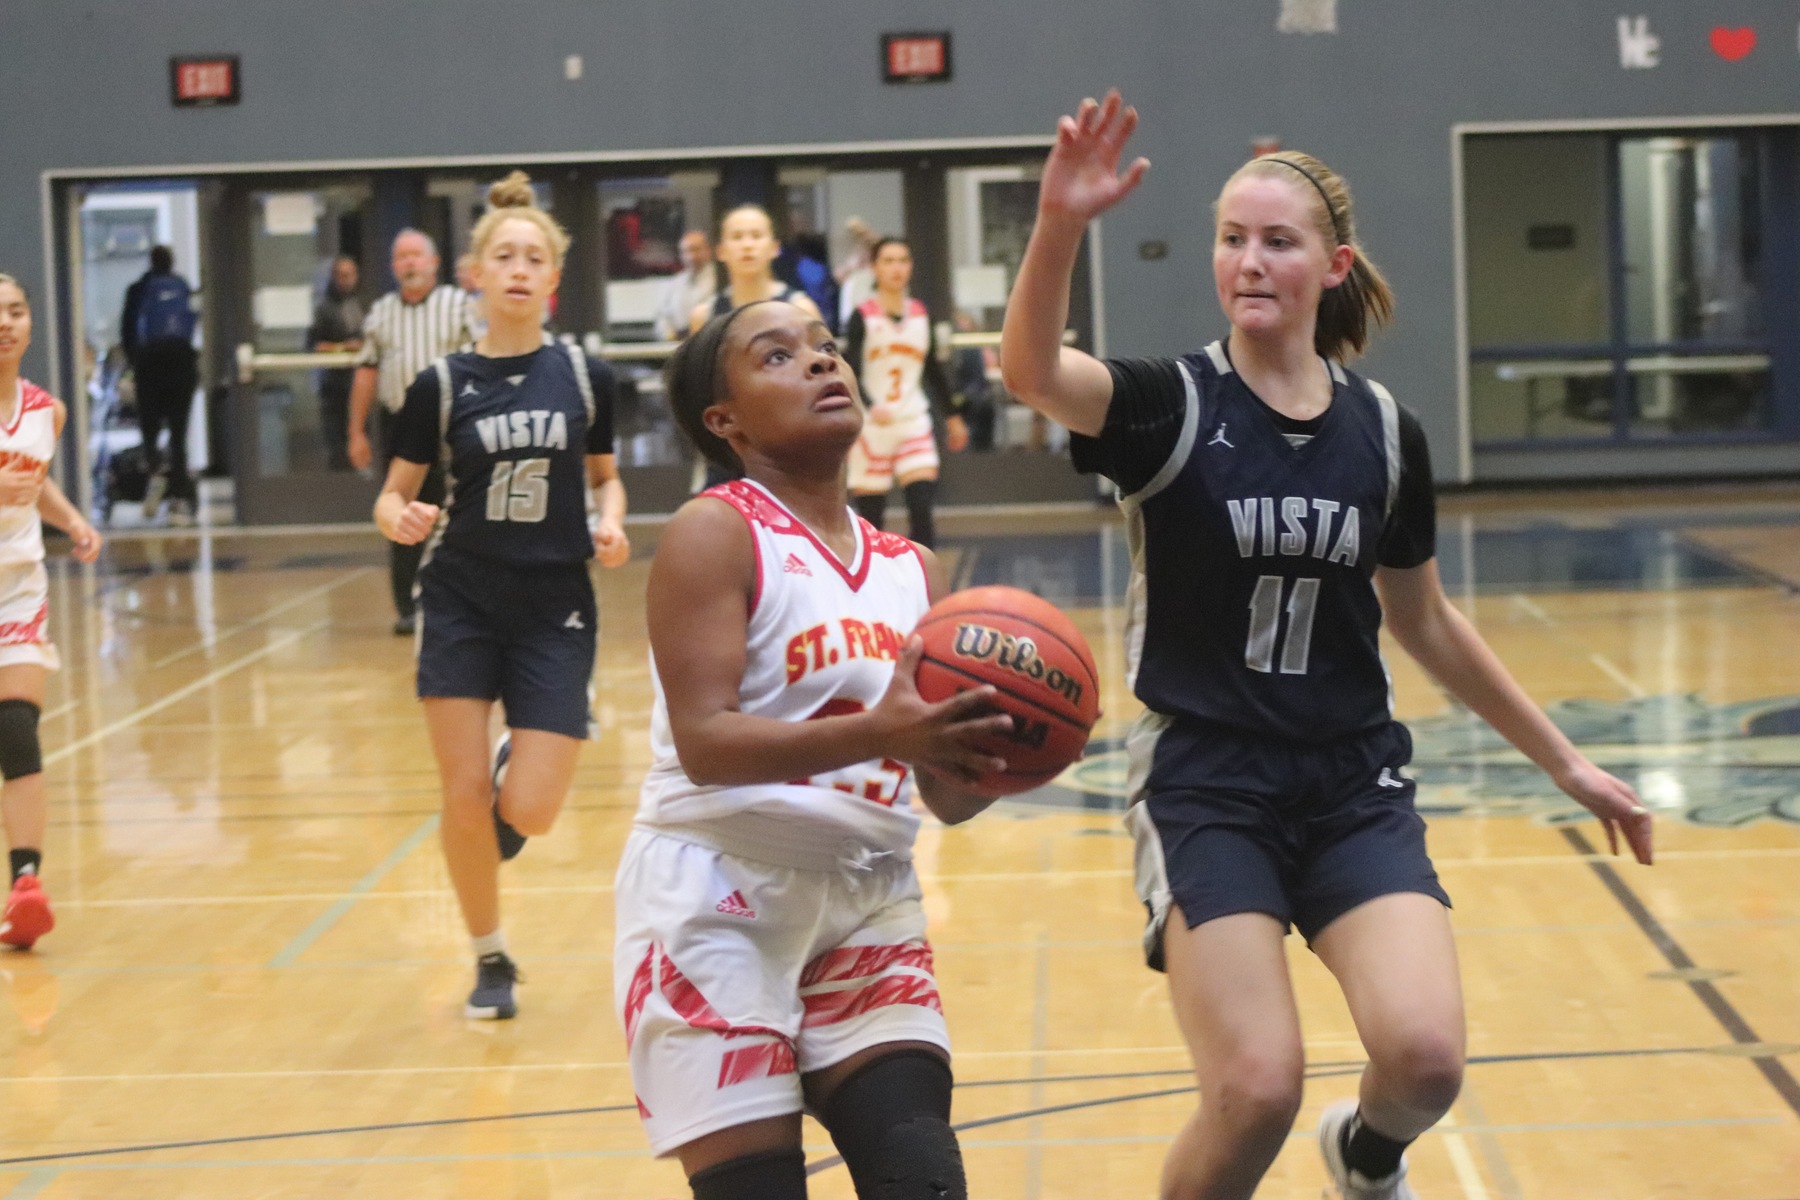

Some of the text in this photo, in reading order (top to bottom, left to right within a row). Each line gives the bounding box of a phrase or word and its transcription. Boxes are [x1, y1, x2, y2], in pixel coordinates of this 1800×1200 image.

[475, 410, 568, 454] VISTA
[485, 457, 550, 523] 15
[1226, 496, 1360, 567] VISTA
[784, 617, 906, 687] ST. FRA
[1245, 575, 1322, 675] 11
[953, 622, 1083, 708] Wilson
